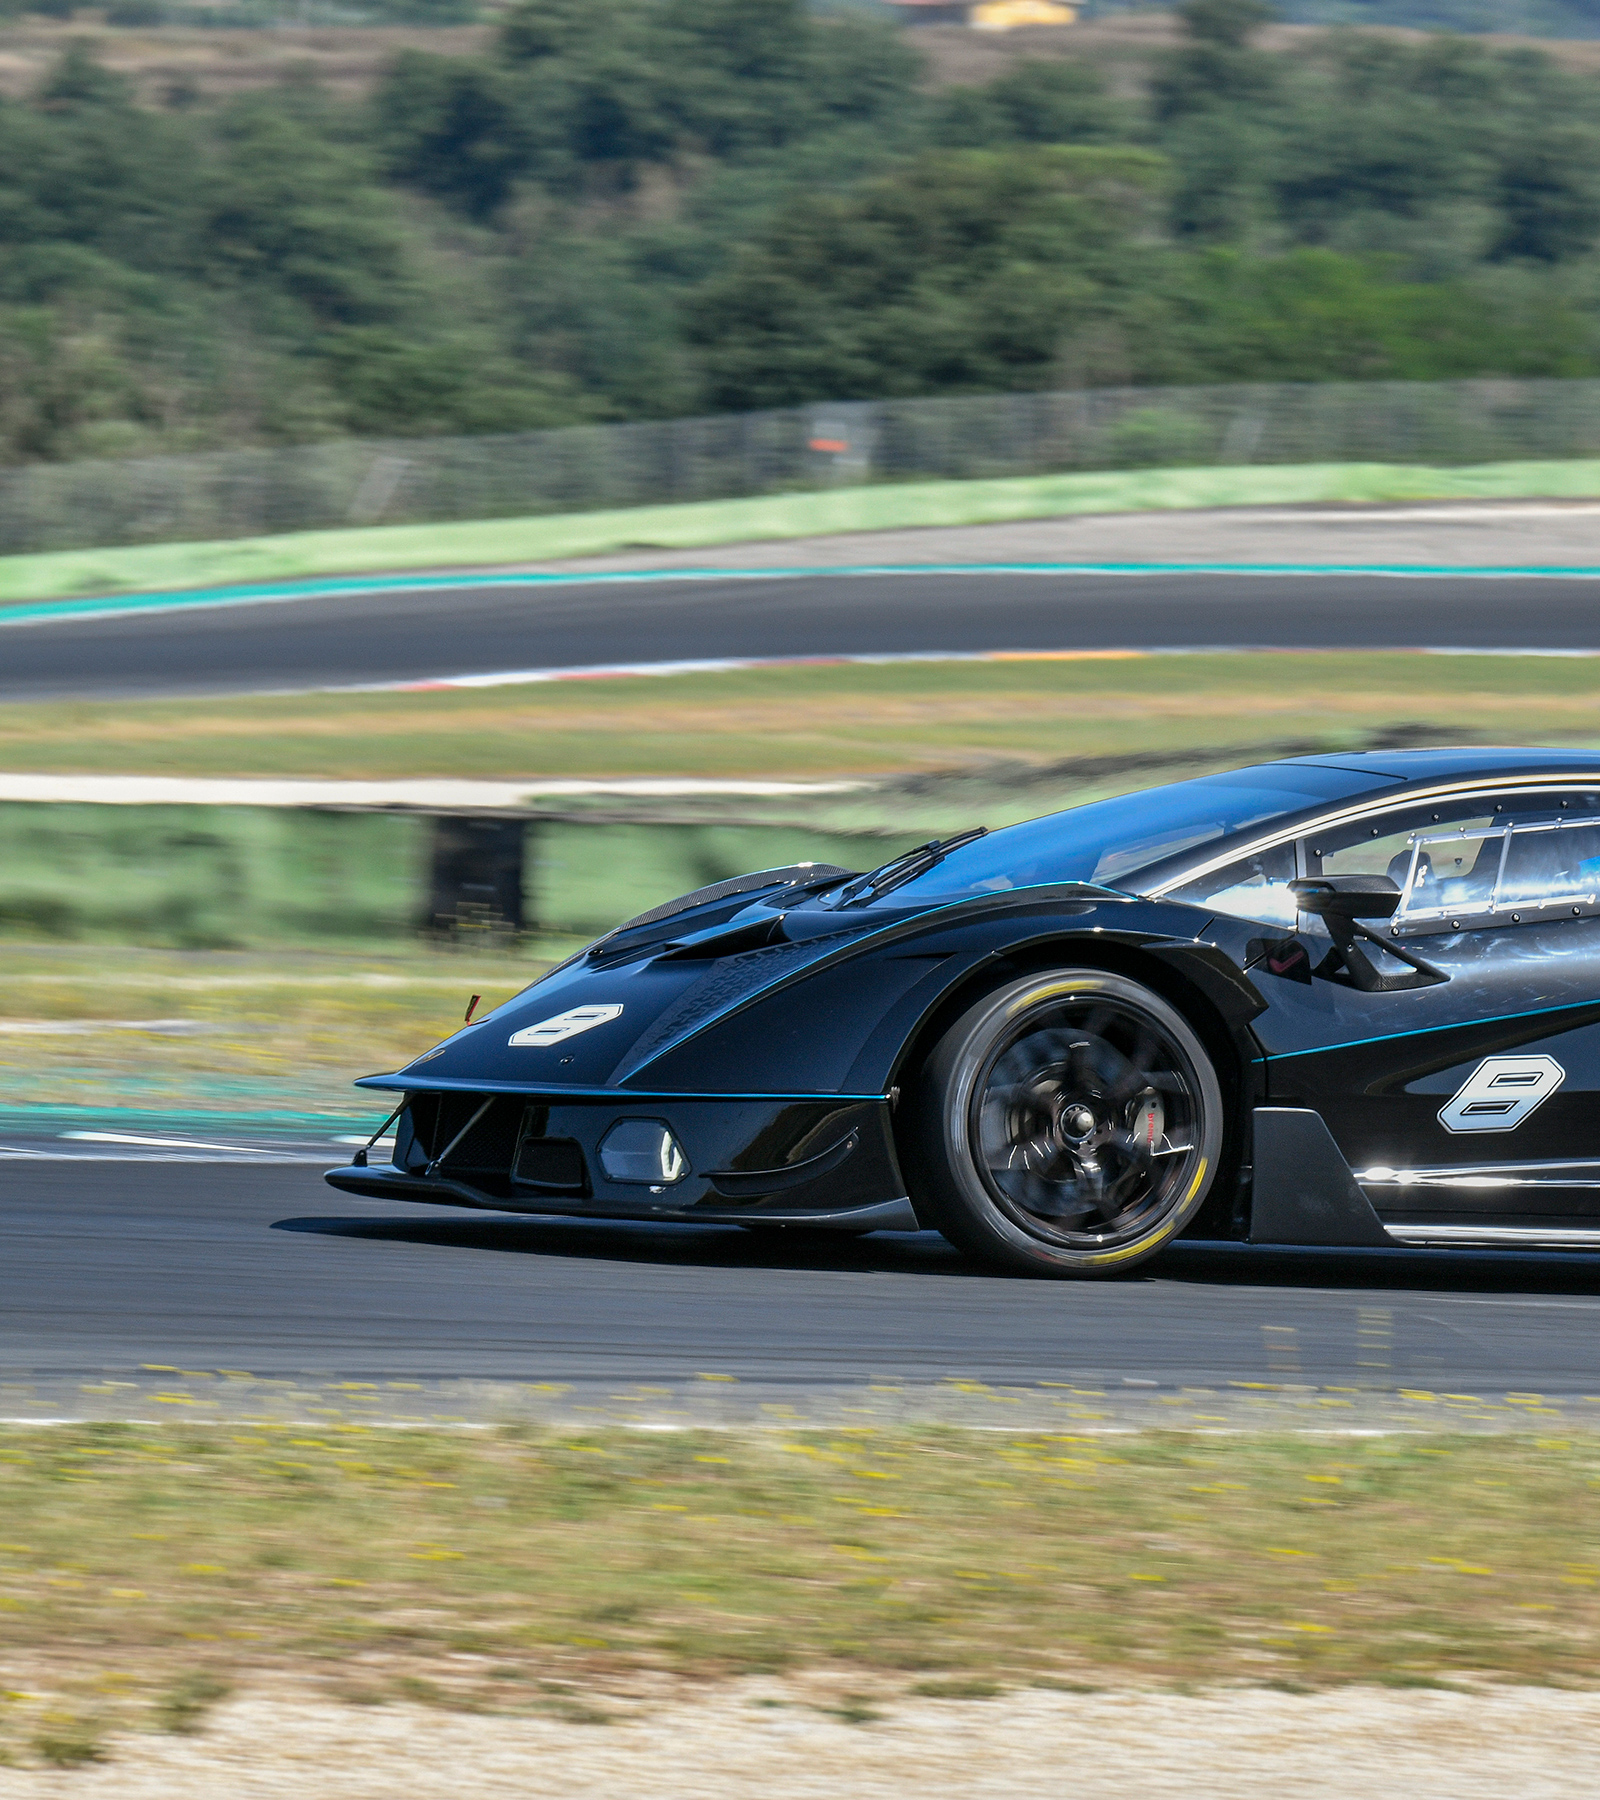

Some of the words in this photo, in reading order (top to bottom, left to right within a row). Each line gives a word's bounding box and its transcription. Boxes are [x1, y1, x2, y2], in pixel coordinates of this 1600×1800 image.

[508, 1003, 624, 1047] 8
[1437, 1054, 1566, 1134] 8
[1147, 1112, 1155, 1146] bremb
